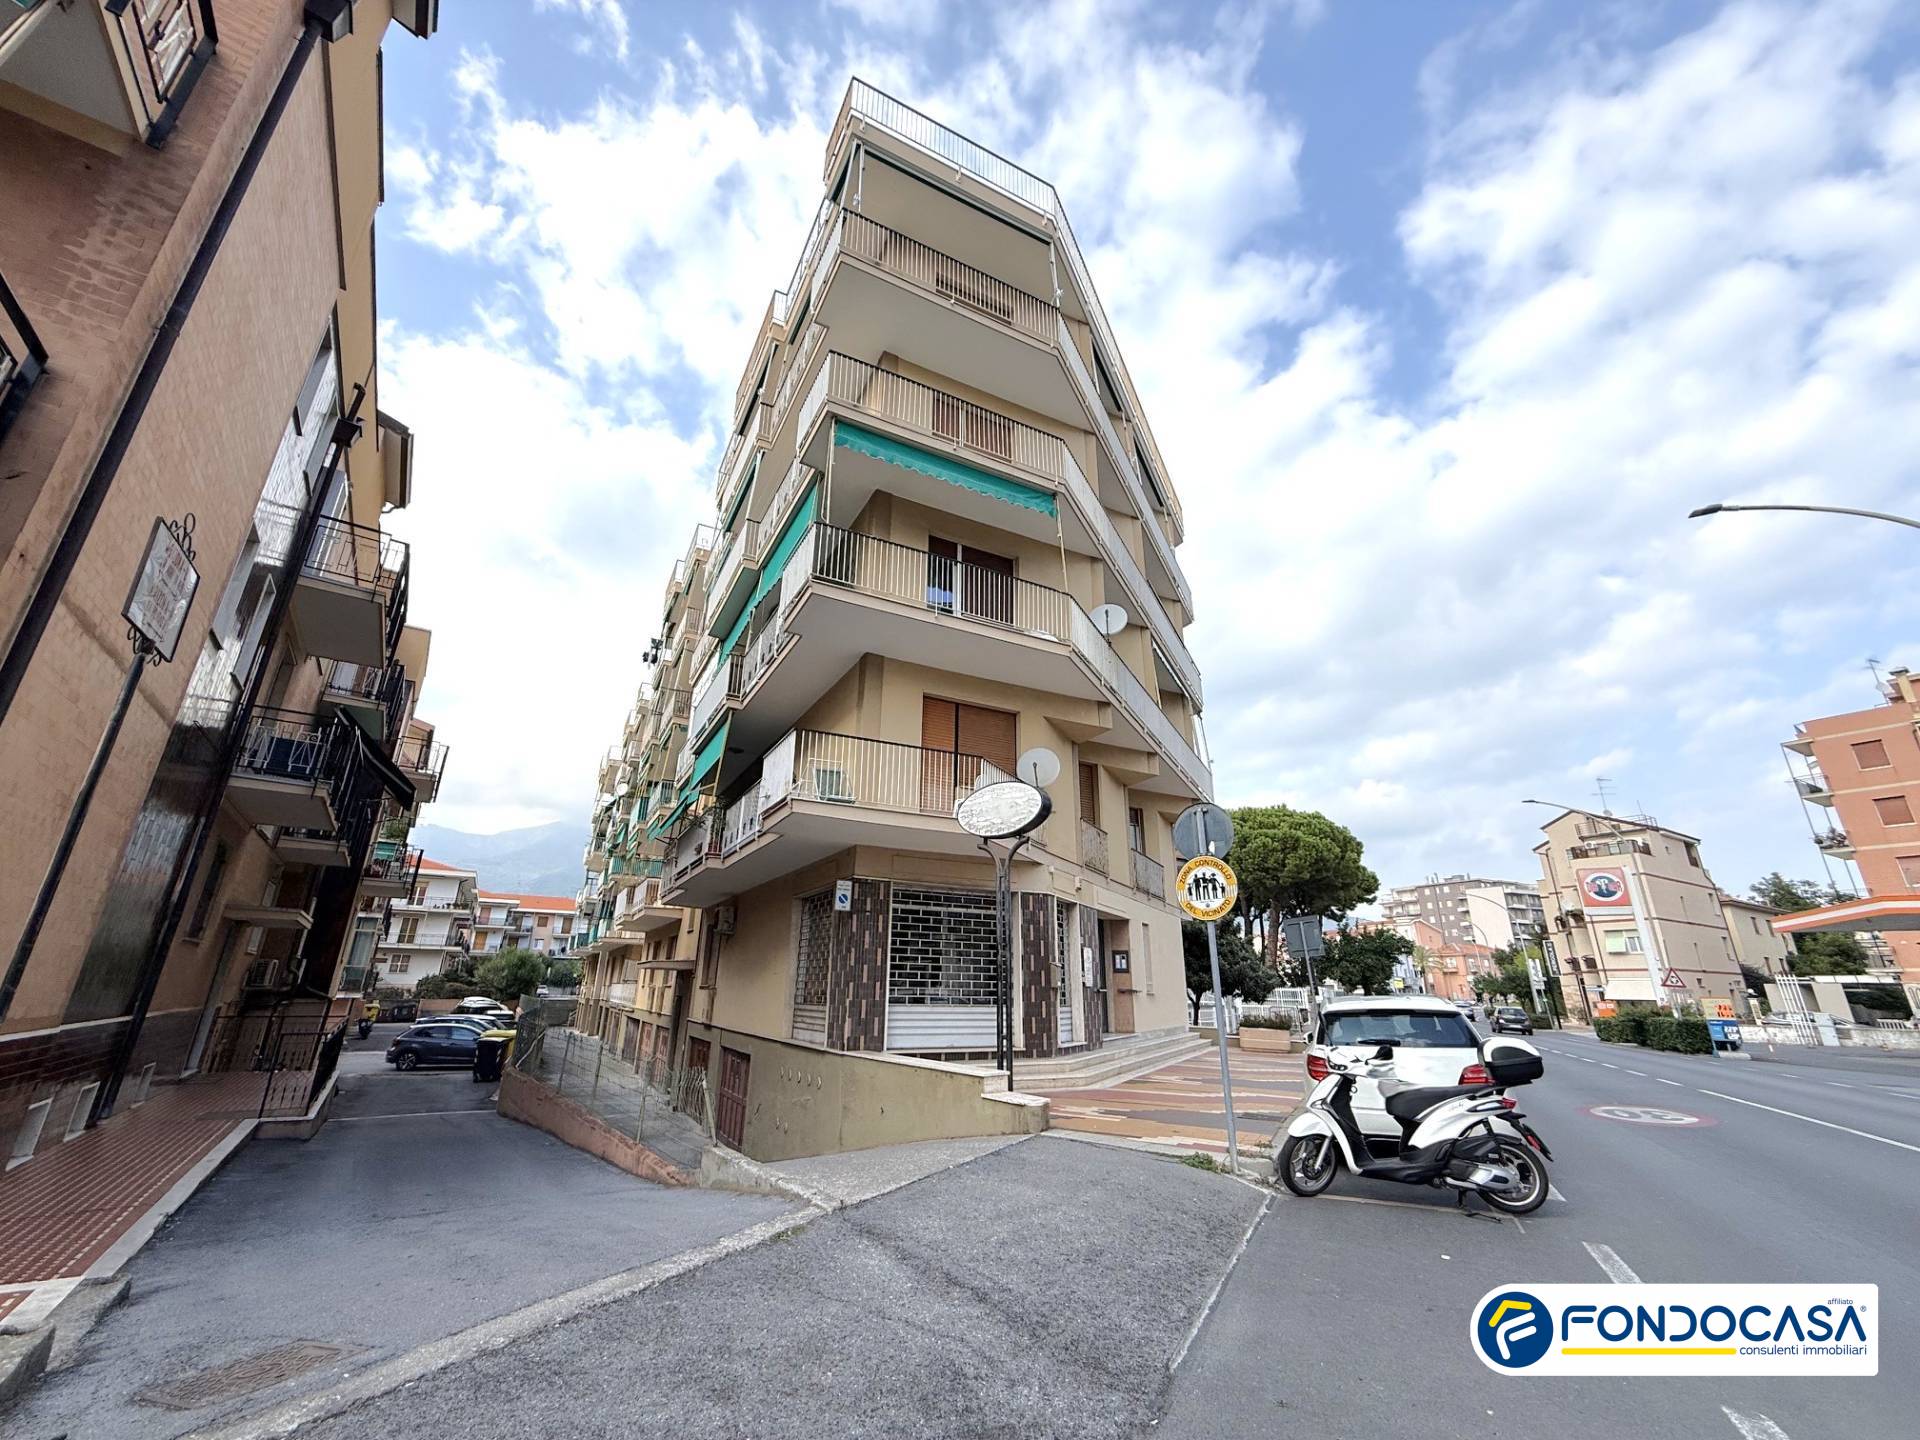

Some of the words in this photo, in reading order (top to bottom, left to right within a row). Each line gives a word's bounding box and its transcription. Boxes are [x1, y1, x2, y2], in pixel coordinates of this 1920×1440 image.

[1180, 866, 1193, 884] ZONA
[1195, 859, 1232, 880] CONTROLLO
[1185, 902, 1200, 915] DEL
[1200, 899, 1231, 917] VICINATO
